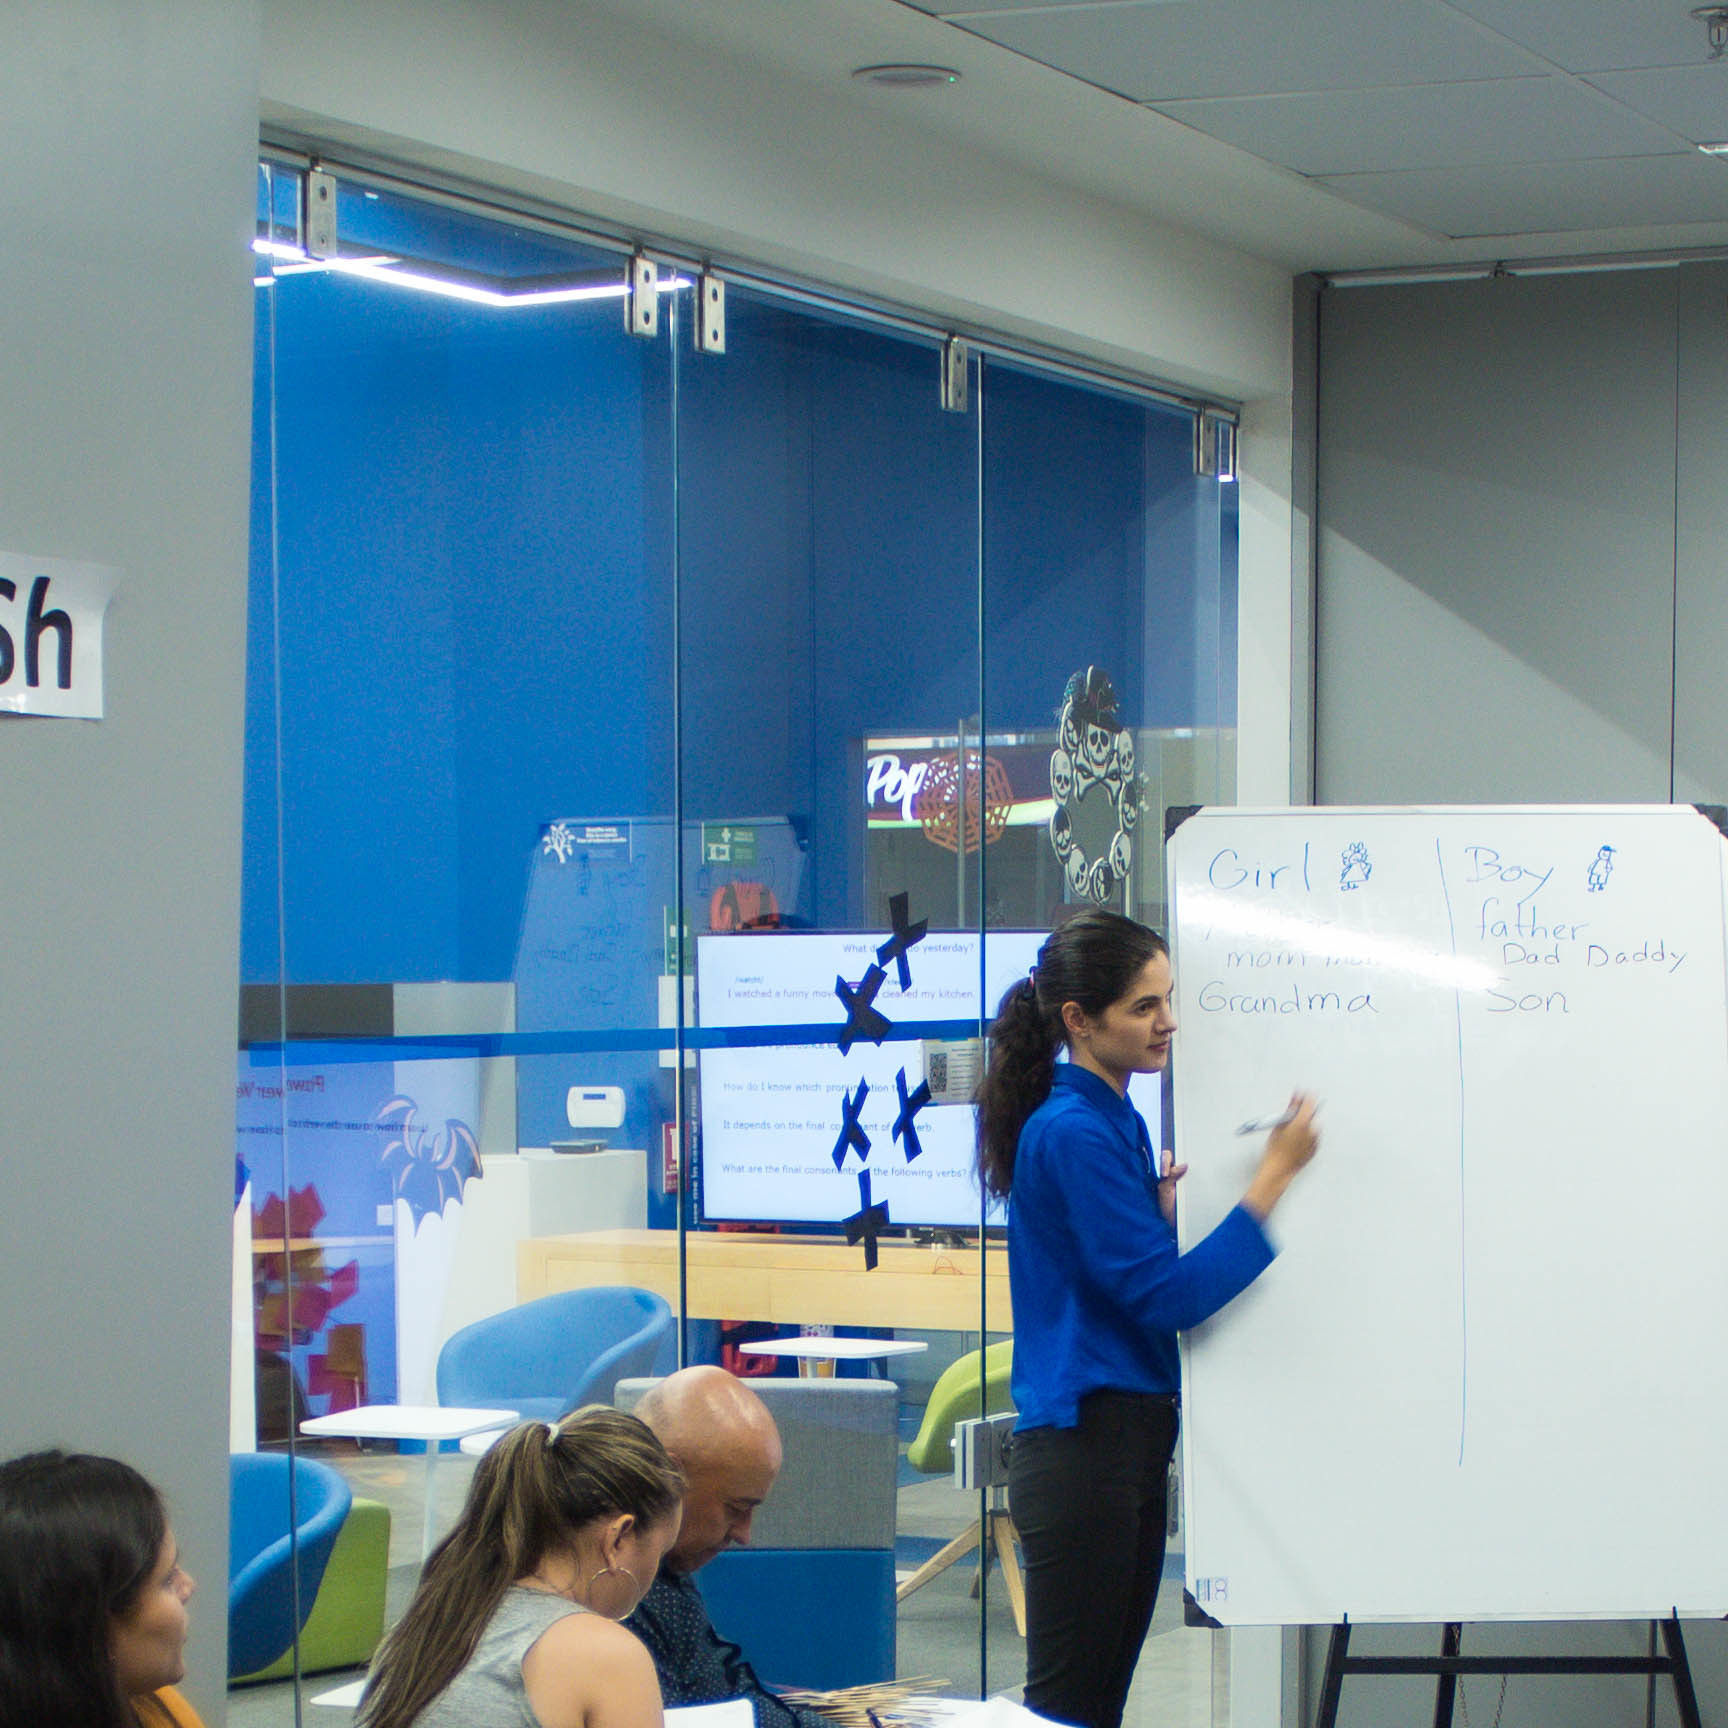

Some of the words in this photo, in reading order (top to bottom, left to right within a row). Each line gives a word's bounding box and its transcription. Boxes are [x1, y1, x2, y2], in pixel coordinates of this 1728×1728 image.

[867, 754, 928, 822] Pop
[1208, 841, 1311, 892] Girl
[1464, 846, 1554, 904] Boy
[1476, 897, 1590, 941] father
[843, 943, 867, 953] What
[922, 943, 975, 956] yesterday?
[1503, 943, 1560, 966] Dad
[1586, 938, 1689, 974] Daddy
[735, 988, 773, 999] watched
[783, 988, 809, 1000] funny
[921, 991, 935, 1001] my
[1198, 981, 1380, 1014] Grandma
[1485, 977, 1569, 1013] Son
[723, 1082, 743, 1092] How
[747, 1082, 758, 1092] do
[768, 1082, 792, 1092] know
[795, 1082, 822, 1093] which
[723, 1119, 731, 1129] It
[733, 1120, 772, 1132] depends
[774, 1122, 786, 1130] on
[788, 1120, 803, 1130] the
[806, 1120, 826, 1130] final
[722, 1163, 745, 1174] What
[748, 1165, 763, 1174] are
[765, 1164, 780, 1174] the
[782, 1164, 802, 1175] final
[873, 1167, 889, 1177] the
[891, 1167, 933, 1180] following
[935, 1168, 968, 1179] verbs?
